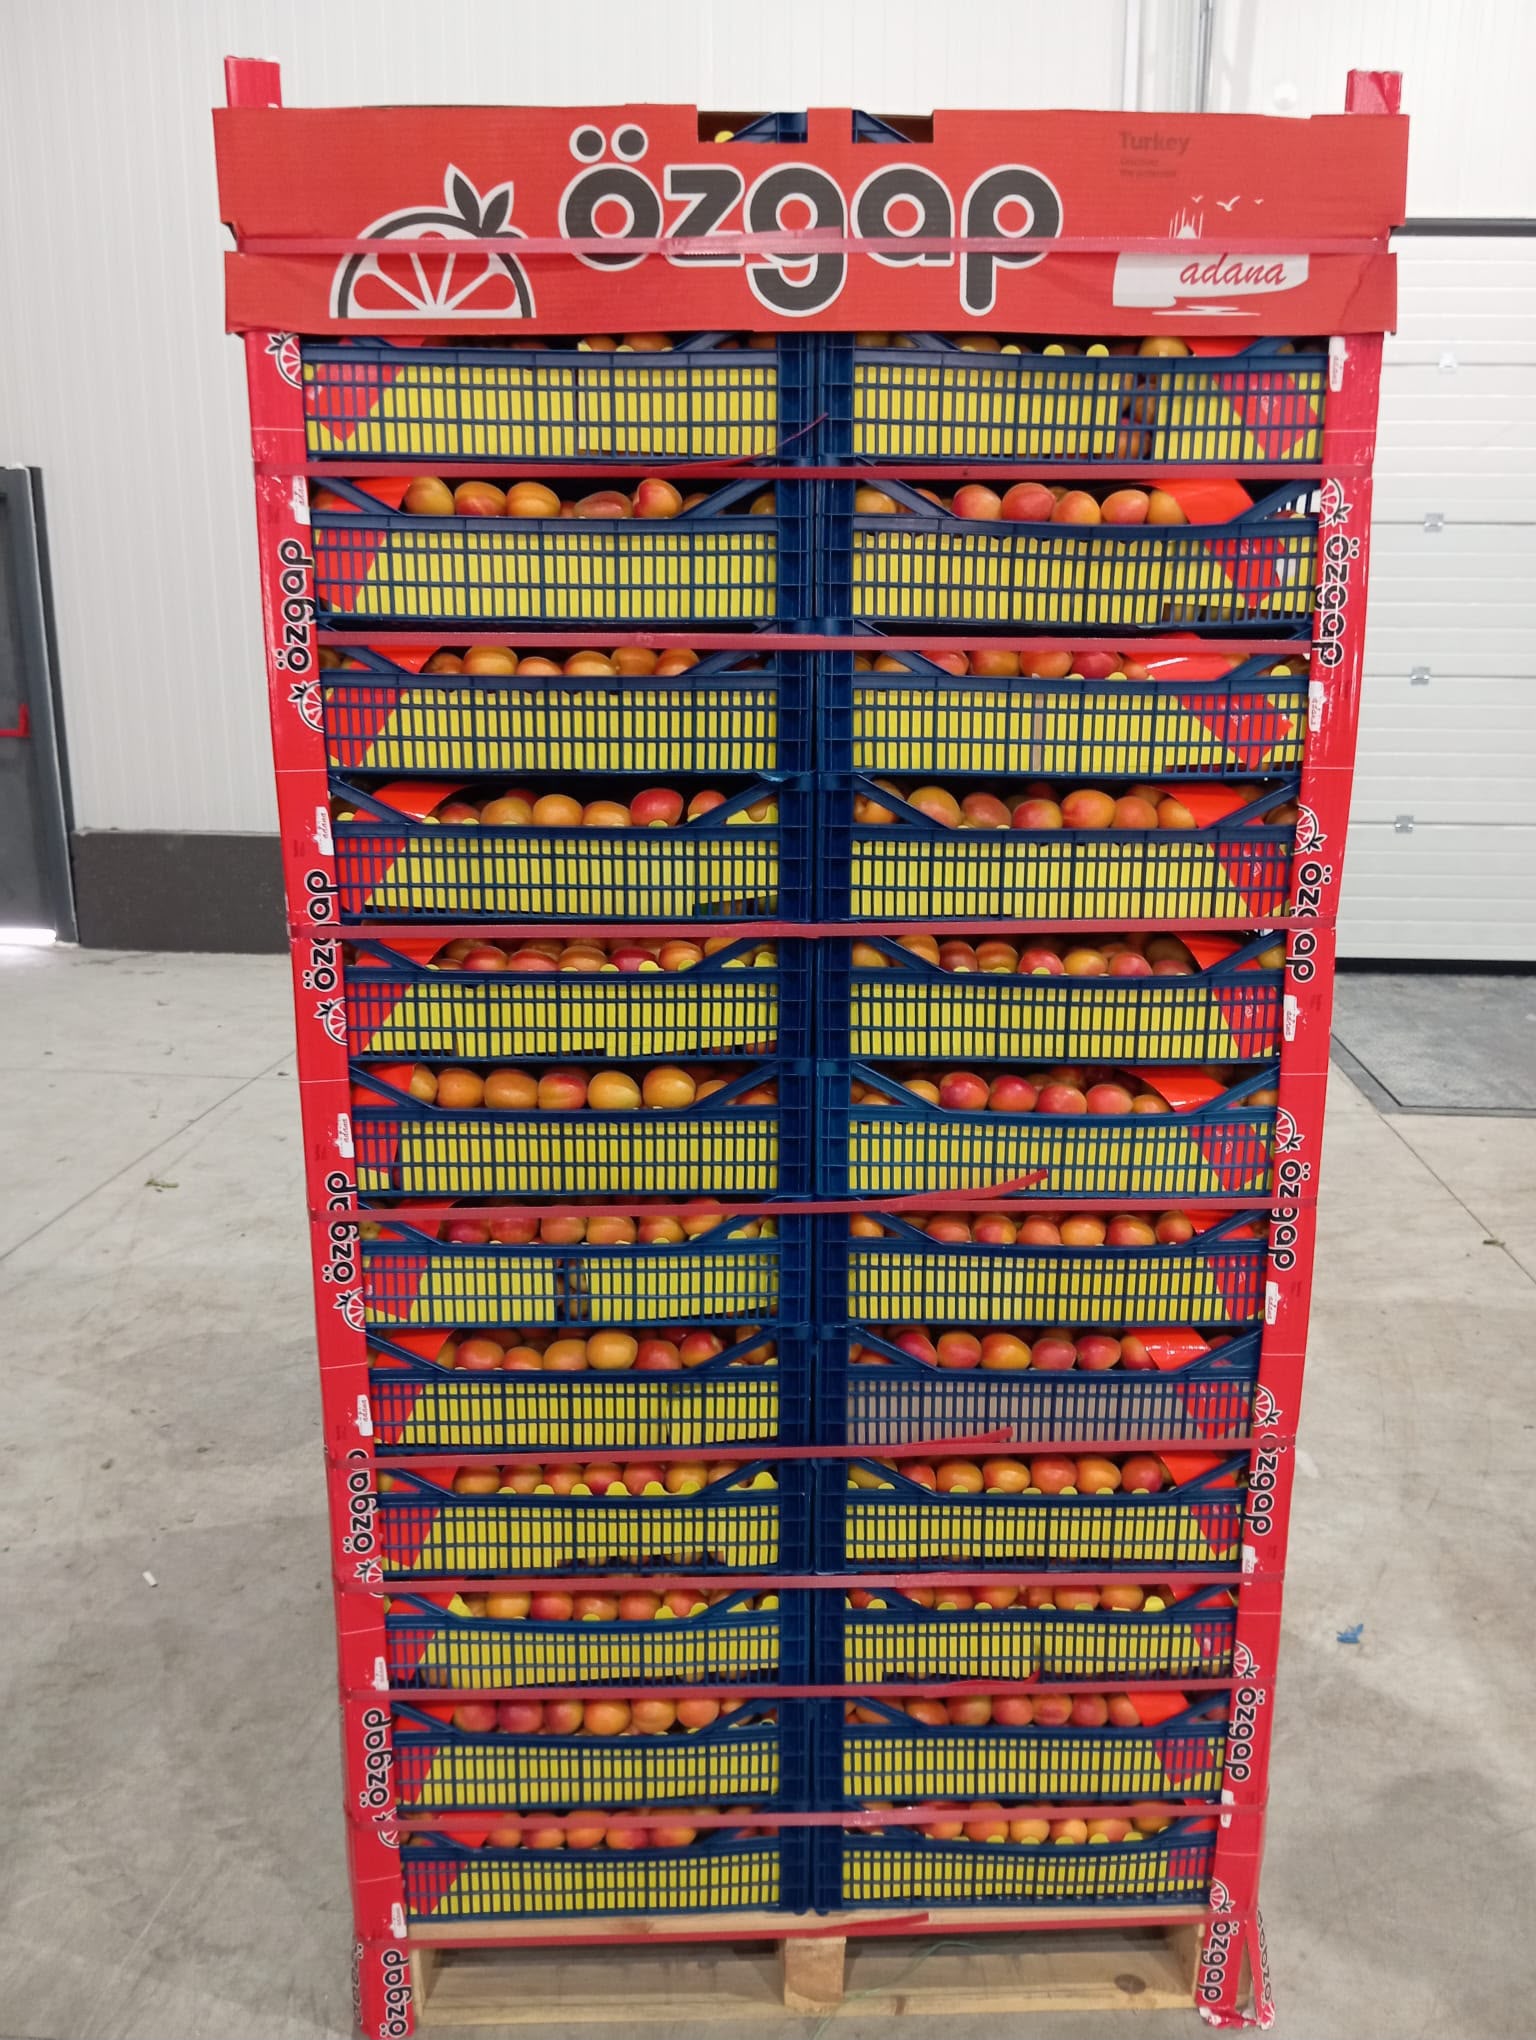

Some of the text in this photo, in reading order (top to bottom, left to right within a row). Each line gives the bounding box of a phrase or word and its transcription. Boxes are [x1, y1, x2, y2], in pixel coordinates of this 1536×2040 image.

[1118, 130, 1190, 156] Turkey
[558, 124, 1064, 317] özgap
[1180, 252, 1287, 285] adana
[275, 537, 316, 674] özgap
[1312, 533, 1360, 668] özgap
[360, 1708, 392, 1808] özgap
[1225, 1687, 1266, 1782] özgap
[380, 1949, 413, 2038] özgap
[1197, 1920, 1240, 2003] özgap
